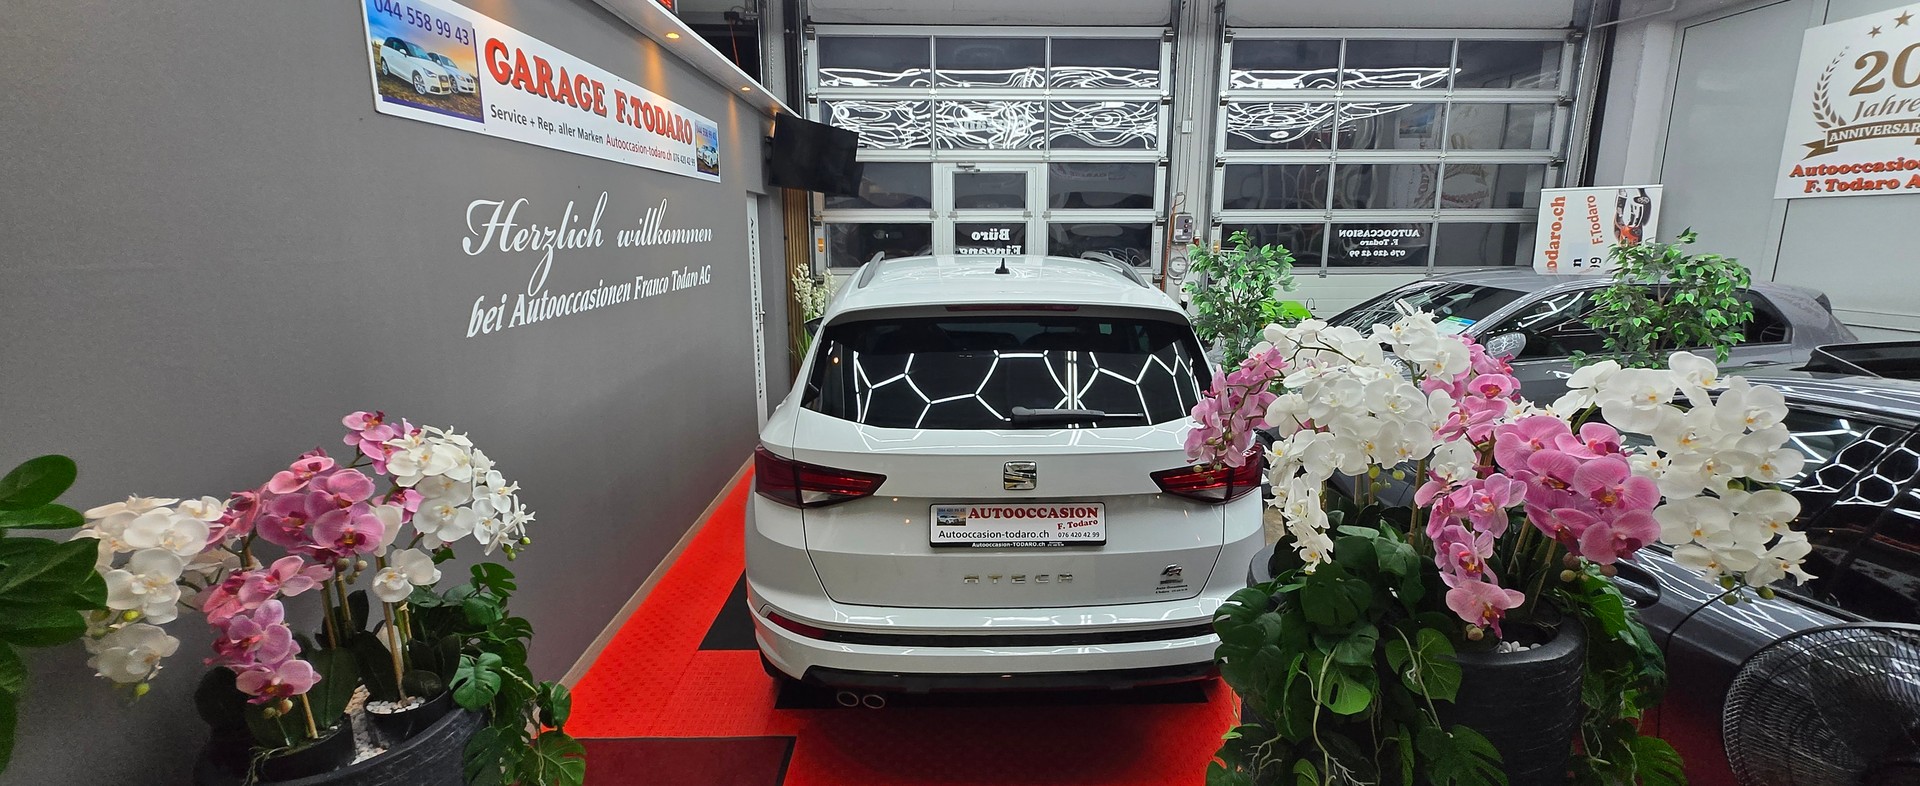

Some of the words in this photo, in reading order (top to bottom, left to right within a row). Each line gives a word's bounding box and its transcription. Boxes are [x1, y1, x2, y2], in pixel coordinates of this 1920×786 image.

[374, 0, 403, 20] 044
[406, 6, 432, 31] 558
[435, 19, 451, 38] 99
[455, 27, 469, 45] 43
[484, 37, 607, 118] GARAGE
[614, 89, 693, 145] F.TODARO
[490, 104, 528, 126] Service
[530, 119, 536, 127] +
[537, 116, 557, 134] Rep.
[558, 121, 576, 138] aller
[577, 127, 604, 145] Marken
[605, 133, 673, 161] Autooccasion-todaro.ch
[1789, 156, 1920, 177] Autooccasio
[1804, 179, 1822, 194] F.
[1824, 177, 1900, 193] Todaro
[1587, 195, 1604, 245] F.Todaro
[462, 191, 608, 297] Herzlich
[616, 198, 713, 248] willkommen
[466, 294, 508, 338] bei
[508, 279, 631, 328] Autooccasionen
[633, 275, 670, 301] Franco
[671, 266, 699, 292] Todaro
[698, 264, 711, 286] AG
[938, 530, 1050, 539] Autooccasion-todaro.ch
[968, 507, 1099, 519] AUTOOCCASION
[1067, 519, 1099, 529] Todaro
